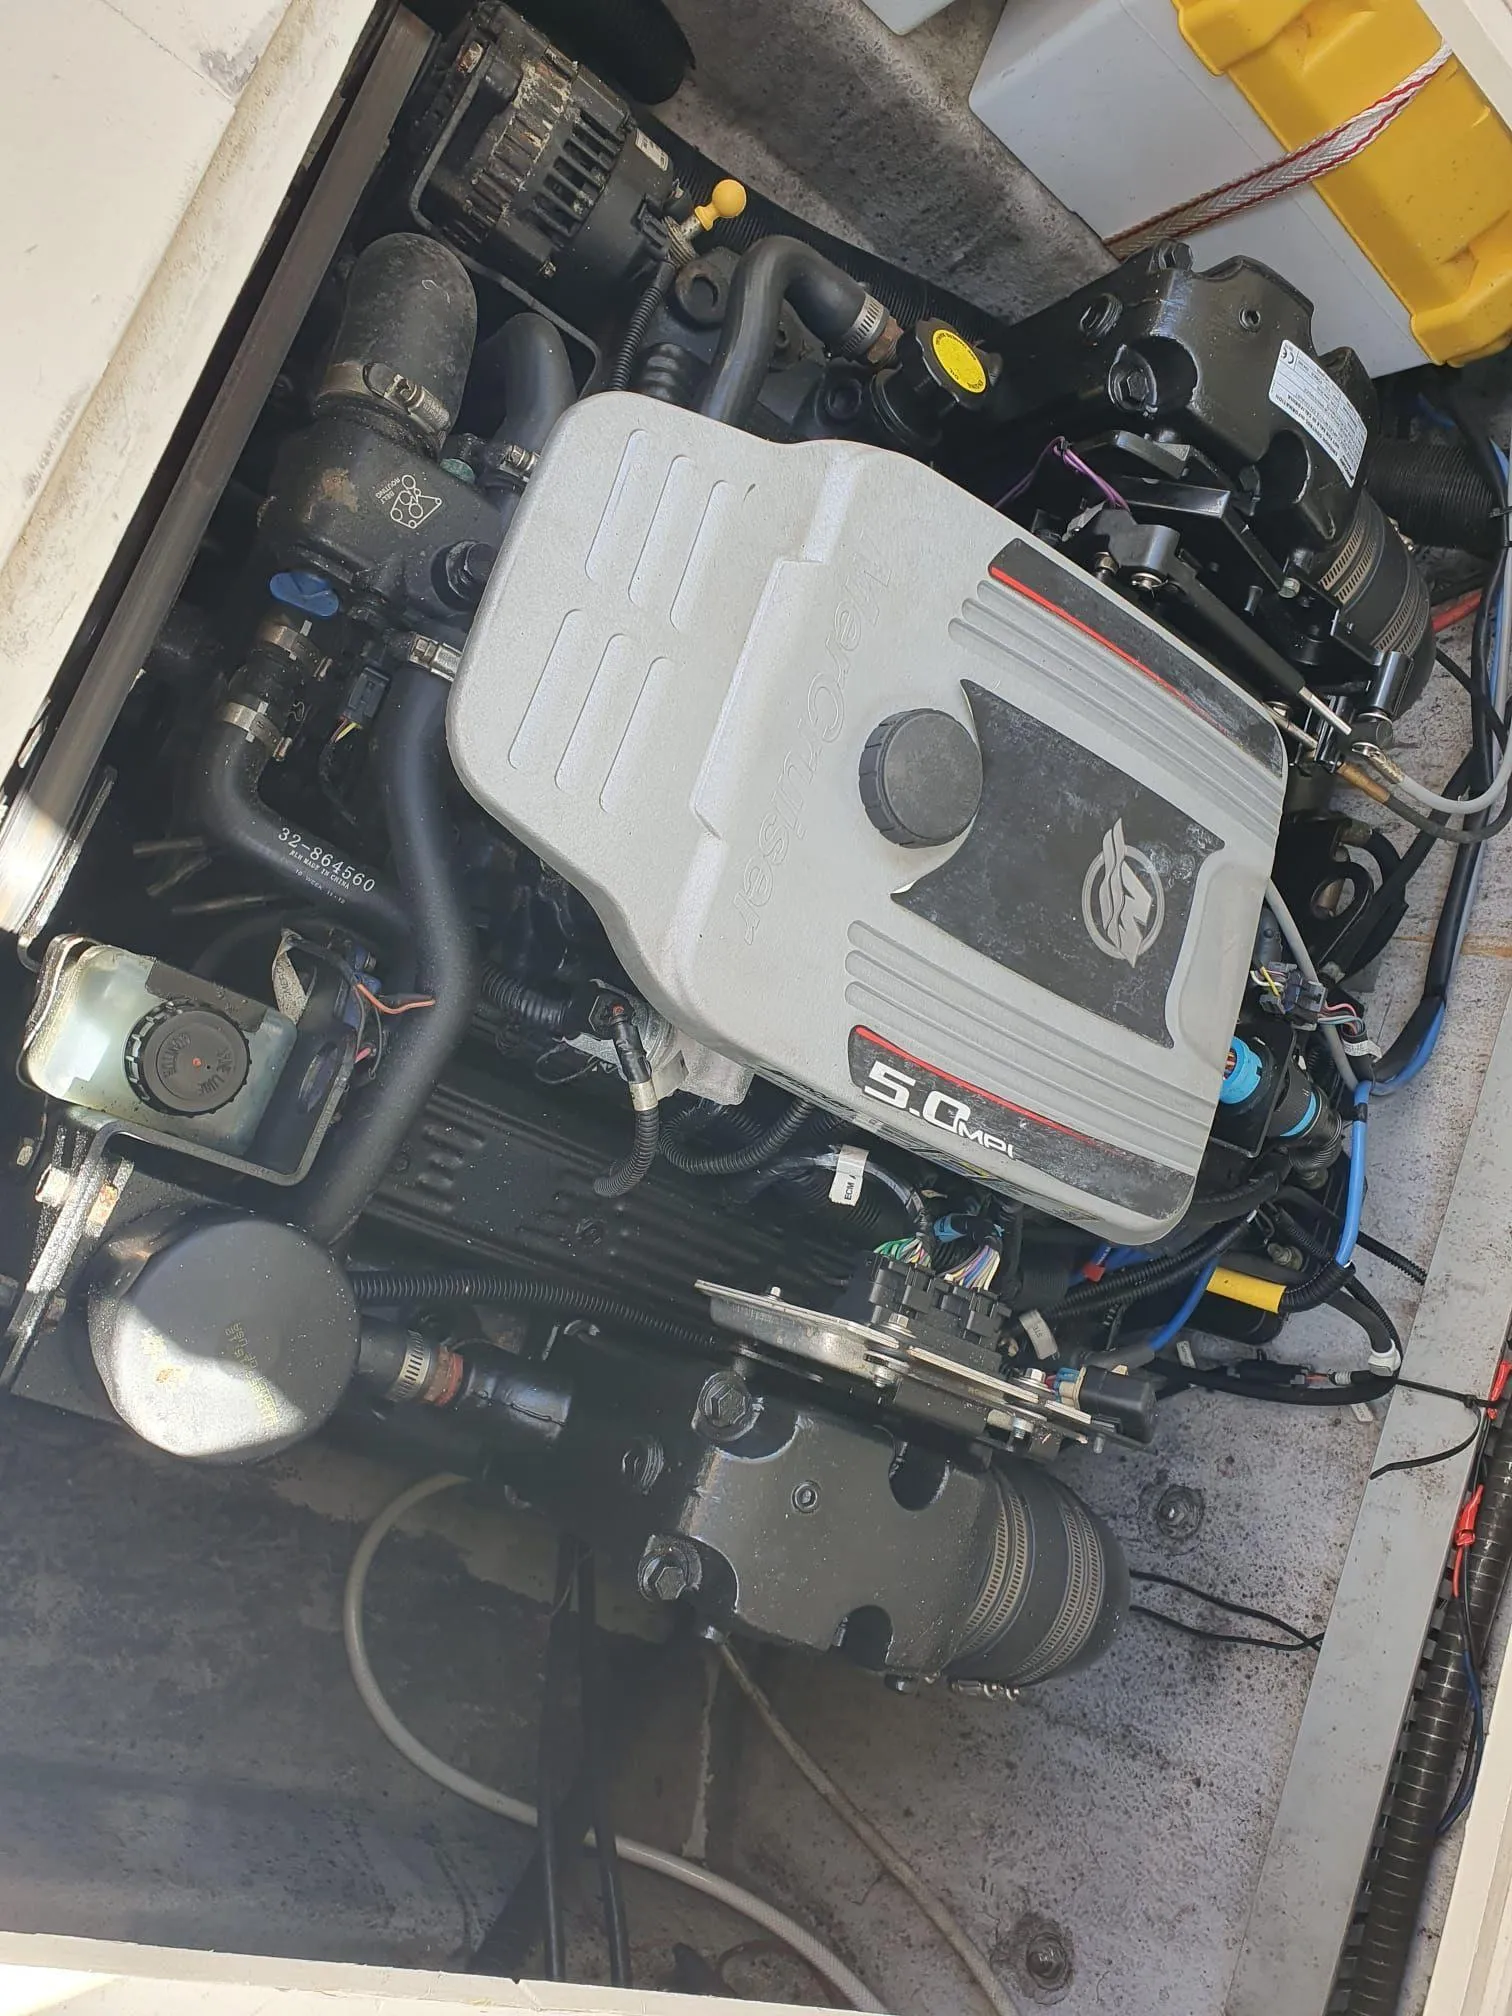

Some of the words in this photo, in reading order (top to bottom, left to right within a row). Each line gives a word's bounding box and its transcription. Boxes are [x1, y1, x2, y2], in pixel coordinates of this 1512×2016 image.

[374, 477, 401, 499] ROUTING
[380, 491, 395, 504] BELT
[732, 566, 893, 946] MerCruiser
[278, 827, 376, 892] 32-864560
[303, 857, 320, 871] MADE
[320, 868, 330, 877] IN
[330, 874, 350, 890] CHINA
[864, 1060, 971, 1133] 5.0
[843, 1181, 856, 1201] ECM
[233, 1322, 248, 1347] USA
[247, 1353, 258, 1368] OF
